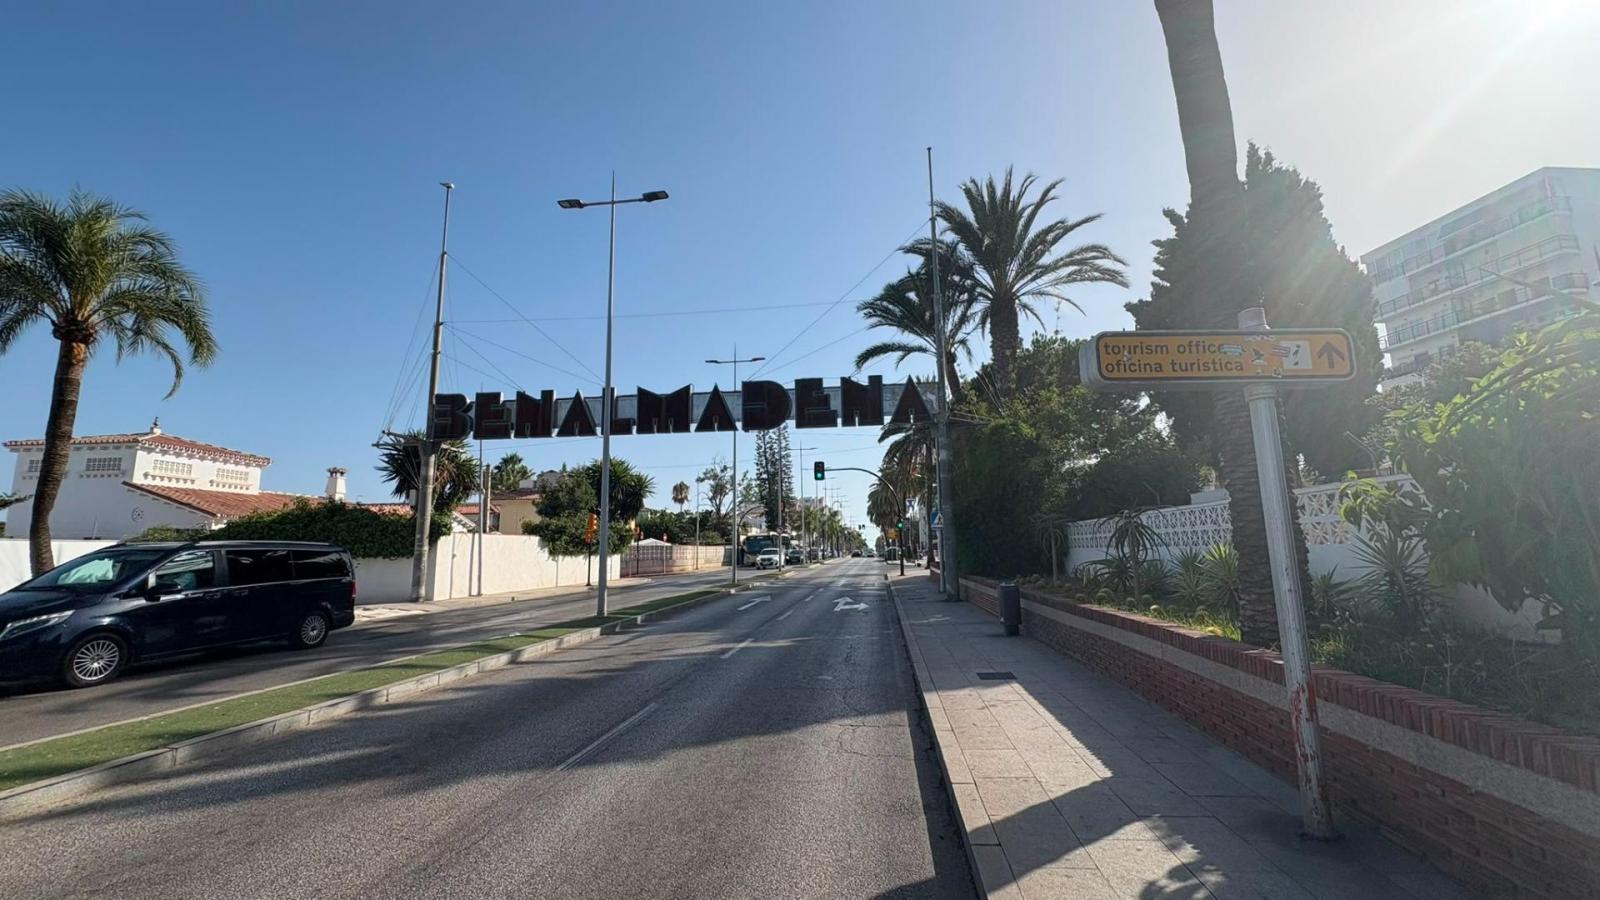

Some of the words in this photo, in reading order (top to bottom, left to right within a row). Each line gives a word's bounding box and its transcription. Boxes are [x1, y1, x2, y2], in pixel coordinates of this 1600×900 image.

[1104, 342, 1169, 356] tourism
[1105, 359, 1163, 373] oficina
[433, 374, 935, 440] BENALMADENA
